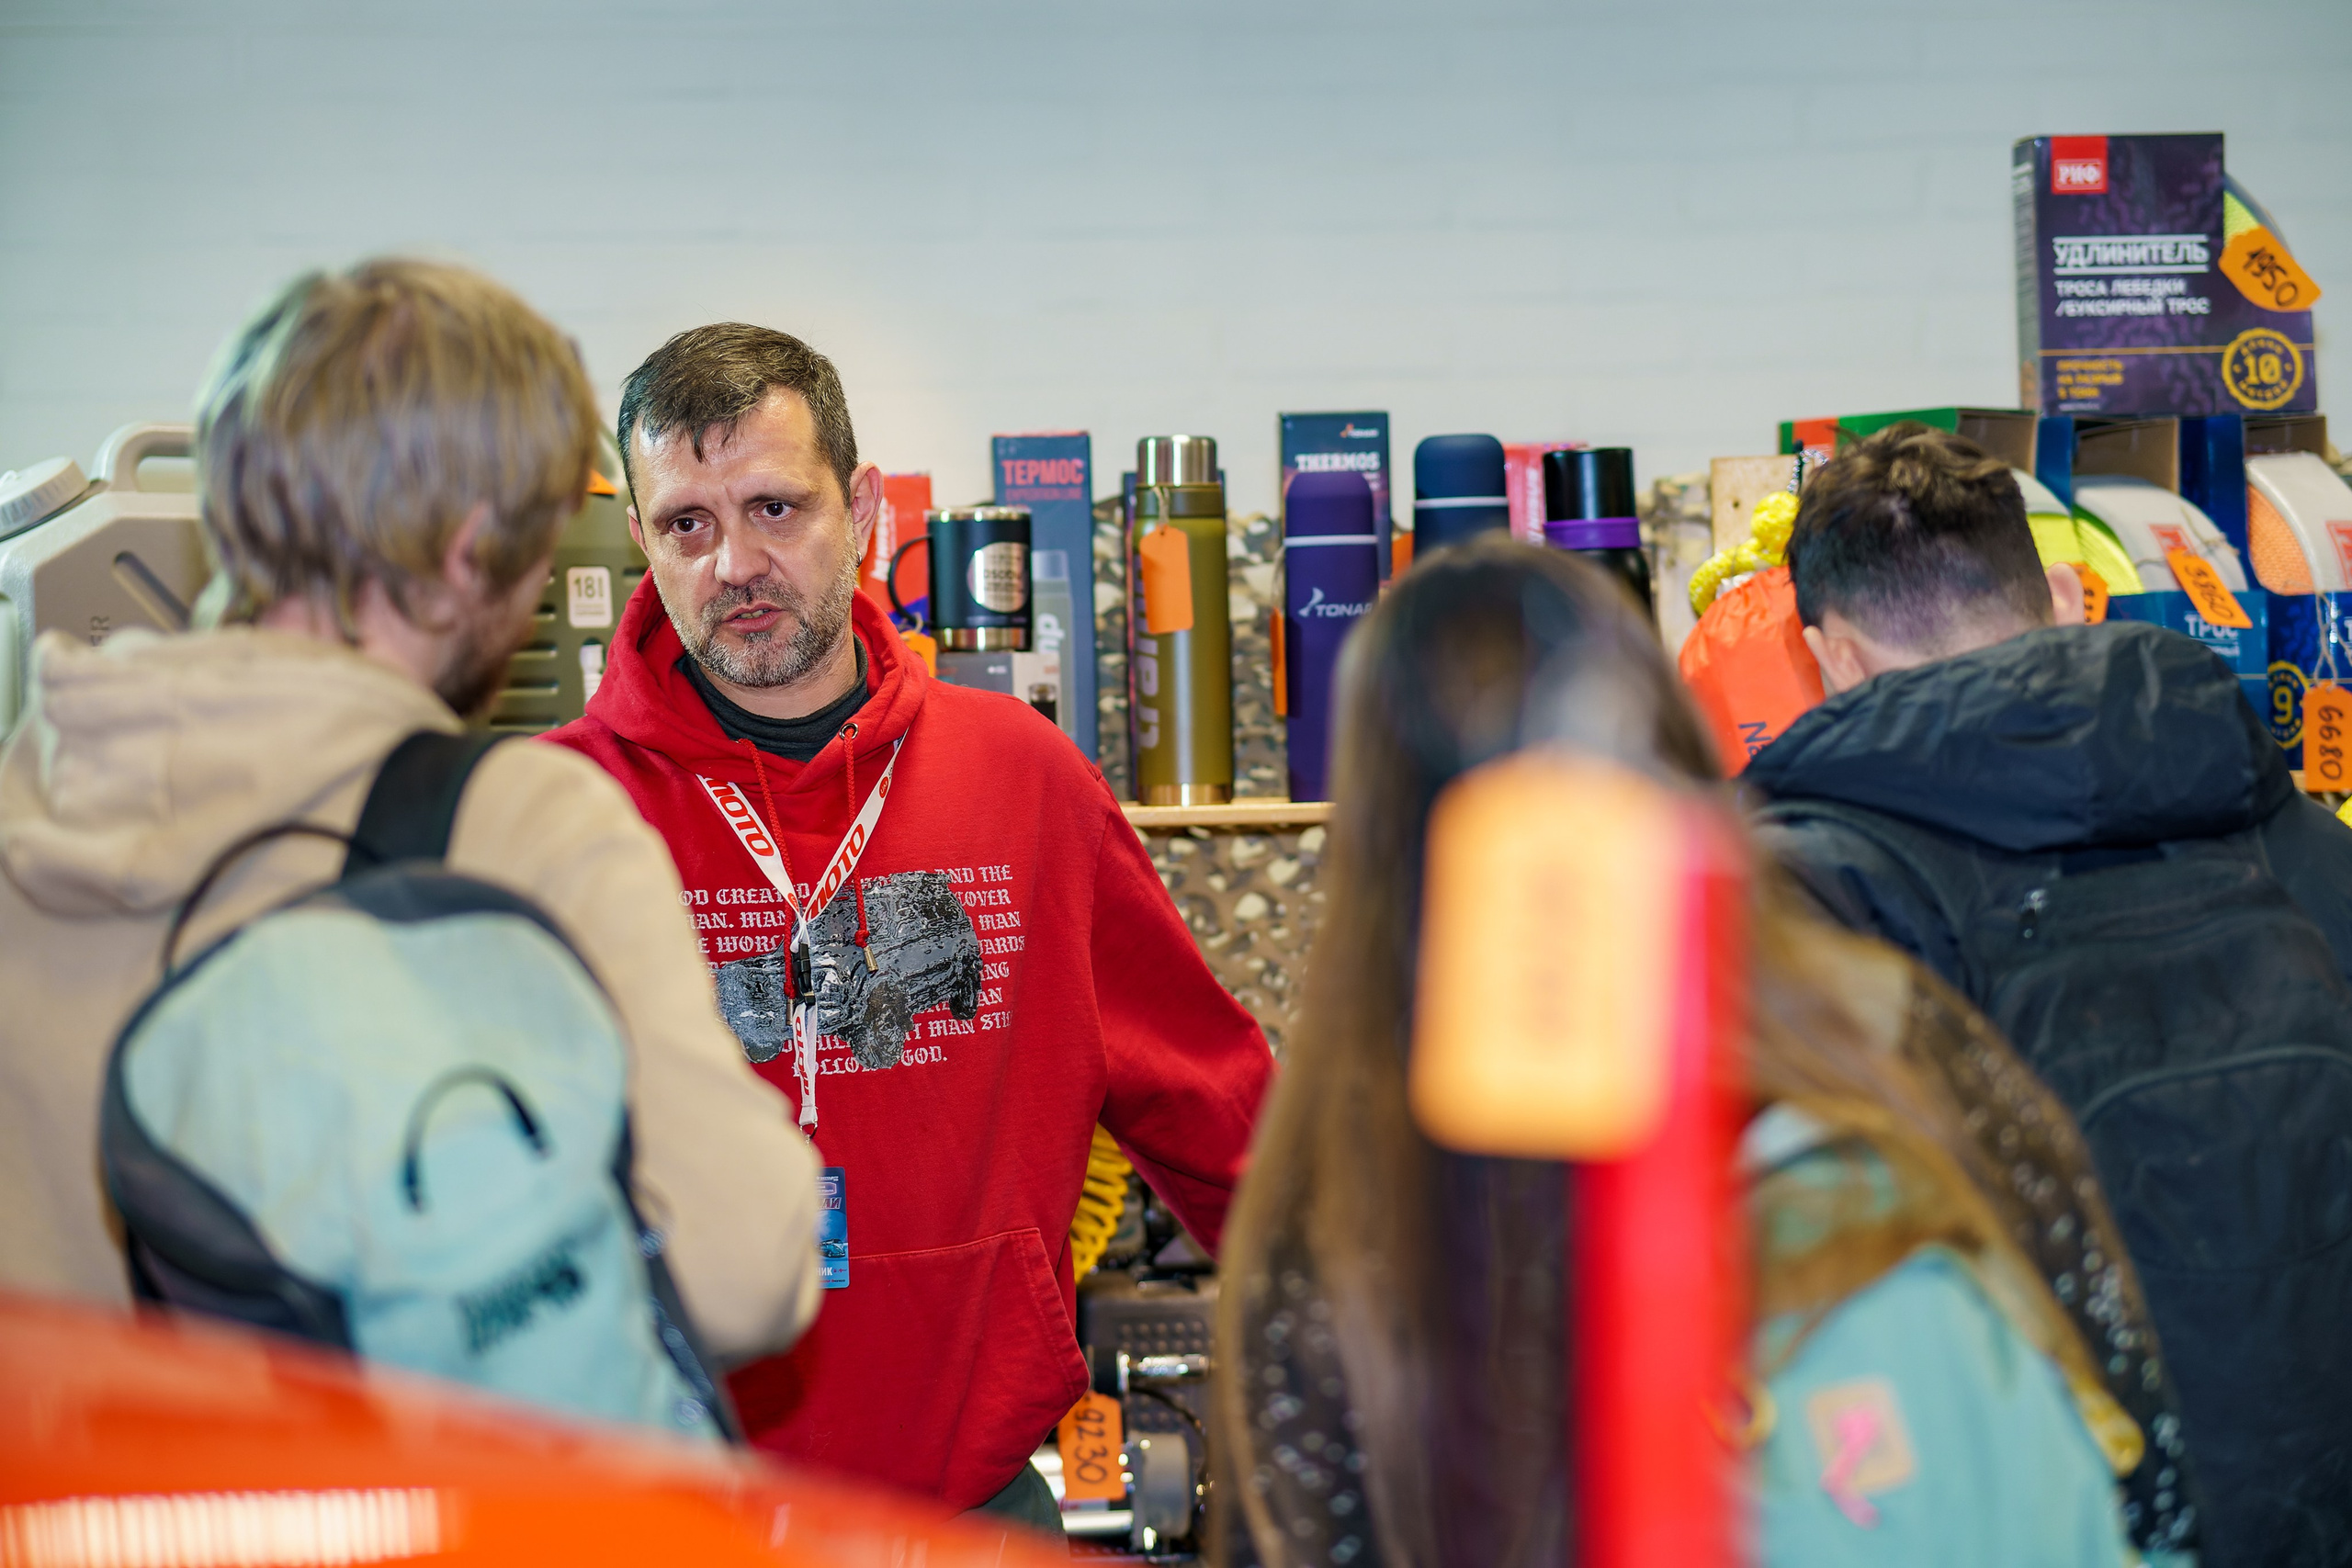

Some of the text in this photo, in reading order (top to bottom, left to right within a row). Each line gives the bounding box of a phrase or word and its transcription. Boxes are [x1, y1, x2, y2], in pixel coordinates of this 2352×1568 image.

[2059, 164, 2101, 184] РИФ
[2053, 243, 2209, 267] УДЛИНИТЕЛЬ
[2054, 279, 2109, 297] ТРОСА
[2166, 297, 2211, 314] ТРОС
[2244, 355, 2282, 385] 10
[1001, 458, 1084, 485] ТЕРМОС
[1295, 452, 1380, 472] THERMOS
[2273, 686, 2293, 725] 9
[2318, 705, 2343, 780] 6680
[677, 889, 708, 906] OD
[717, 884, 810, 905] CREAD
[978, 864, 1012, 882] THE
[978, 911, 1021, 931] MAN
[928, 1018, 975, 1038] MAN
[900, 1045, 947, 1066] GOD.
[1073, 1408, 1108, 1484] 9230
